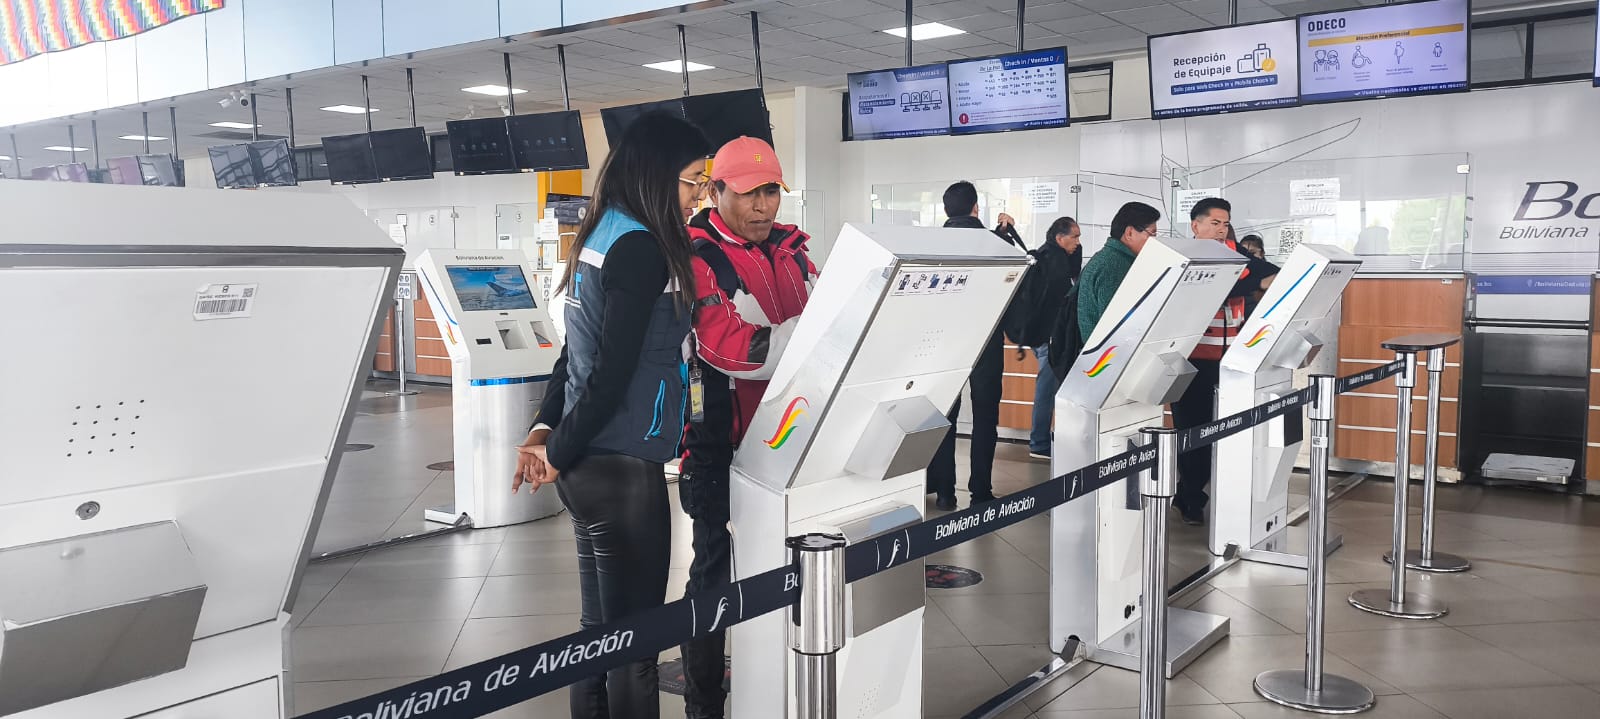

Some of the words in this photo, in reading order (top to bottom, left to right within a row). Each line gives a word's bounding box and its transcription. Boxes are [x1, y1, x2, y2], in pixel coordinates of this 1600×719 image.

[1307, 17, 1347, 32] ODECO
[1030, 56, 1049, 64] Ventas
[1173, 53, 1226, 67] Recepción
[1174, 69, 1187, 79] de
[1188, 65, 1232, 80] Equipaje
[1208, 82, 1223, 90] Check
[1252, 78, 1268, 86] Check
[1499, 226, 1589, 240] Boliviana
[1199, 424, 1219, 439] Boliviana
[1218, 421, 1226, 432] de
[1226, 416, 1243, 429] Aviación
[1098, 458, 1127, 479] Boliviana
[1128, 453, 1137, 466] de
[935, 513, 980, 541] Boliviana
[983, 506, 996, 523] de
[998, 496, 1035, 519] Aviación
[483, 664, 520, 692] de
[529, 629, 634, 679] Aviación
